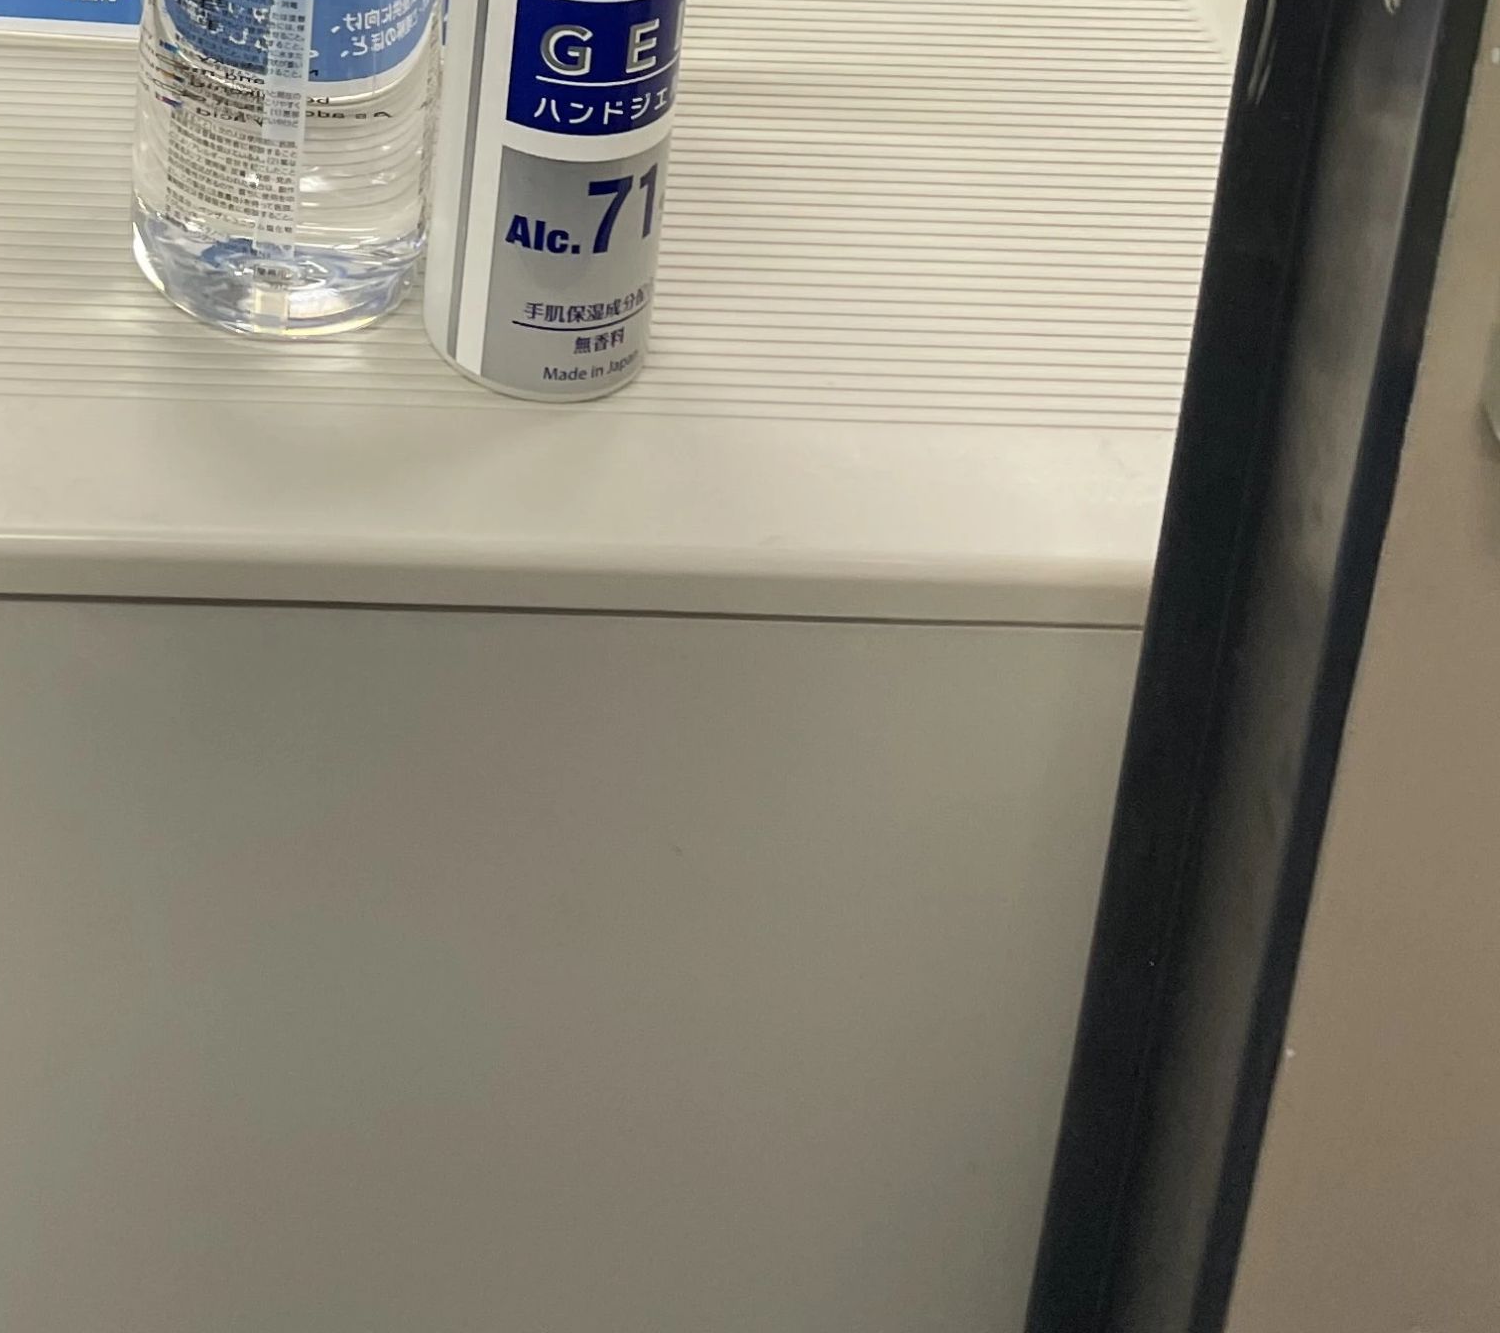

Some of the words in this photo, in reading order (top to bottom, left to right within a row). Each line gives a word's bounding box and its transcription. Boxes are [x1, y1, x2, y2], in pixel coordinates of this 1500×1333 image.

[533, 86, 672, 125] ハンドジェ
[504, 213, 582, 254] Alc.
[573, 326, 626, 355] 無香料
[542, 366, 588, 381] Made
[590, 365, 604, 379] in
